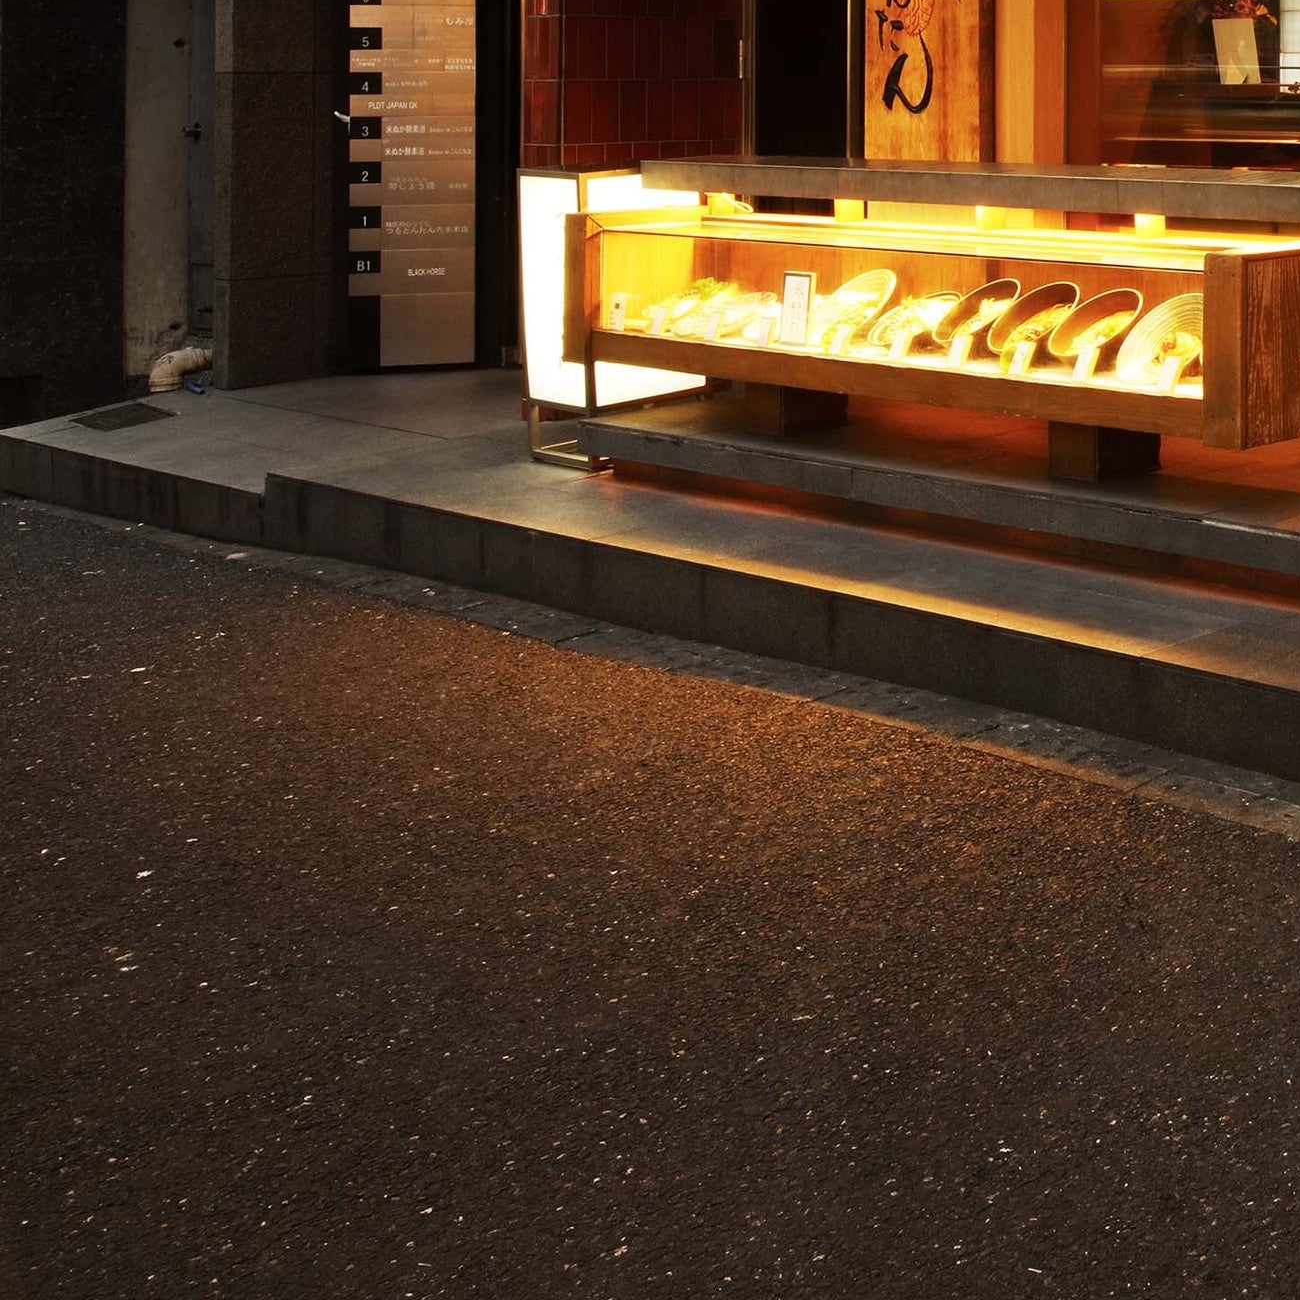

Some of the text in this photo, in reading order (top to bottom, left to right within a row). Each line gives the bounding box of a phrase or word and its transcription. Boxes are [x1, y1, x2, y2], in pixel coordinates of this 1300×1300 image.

[361, 36, 370, 48] 5
[361, 81, 370, 93] 4
[386, 101, 408, 110] JAPAN
[361, 125, 370, 138] 3
[361, 170, 369, 182] 2
[356, 260, 371, 272] B1
